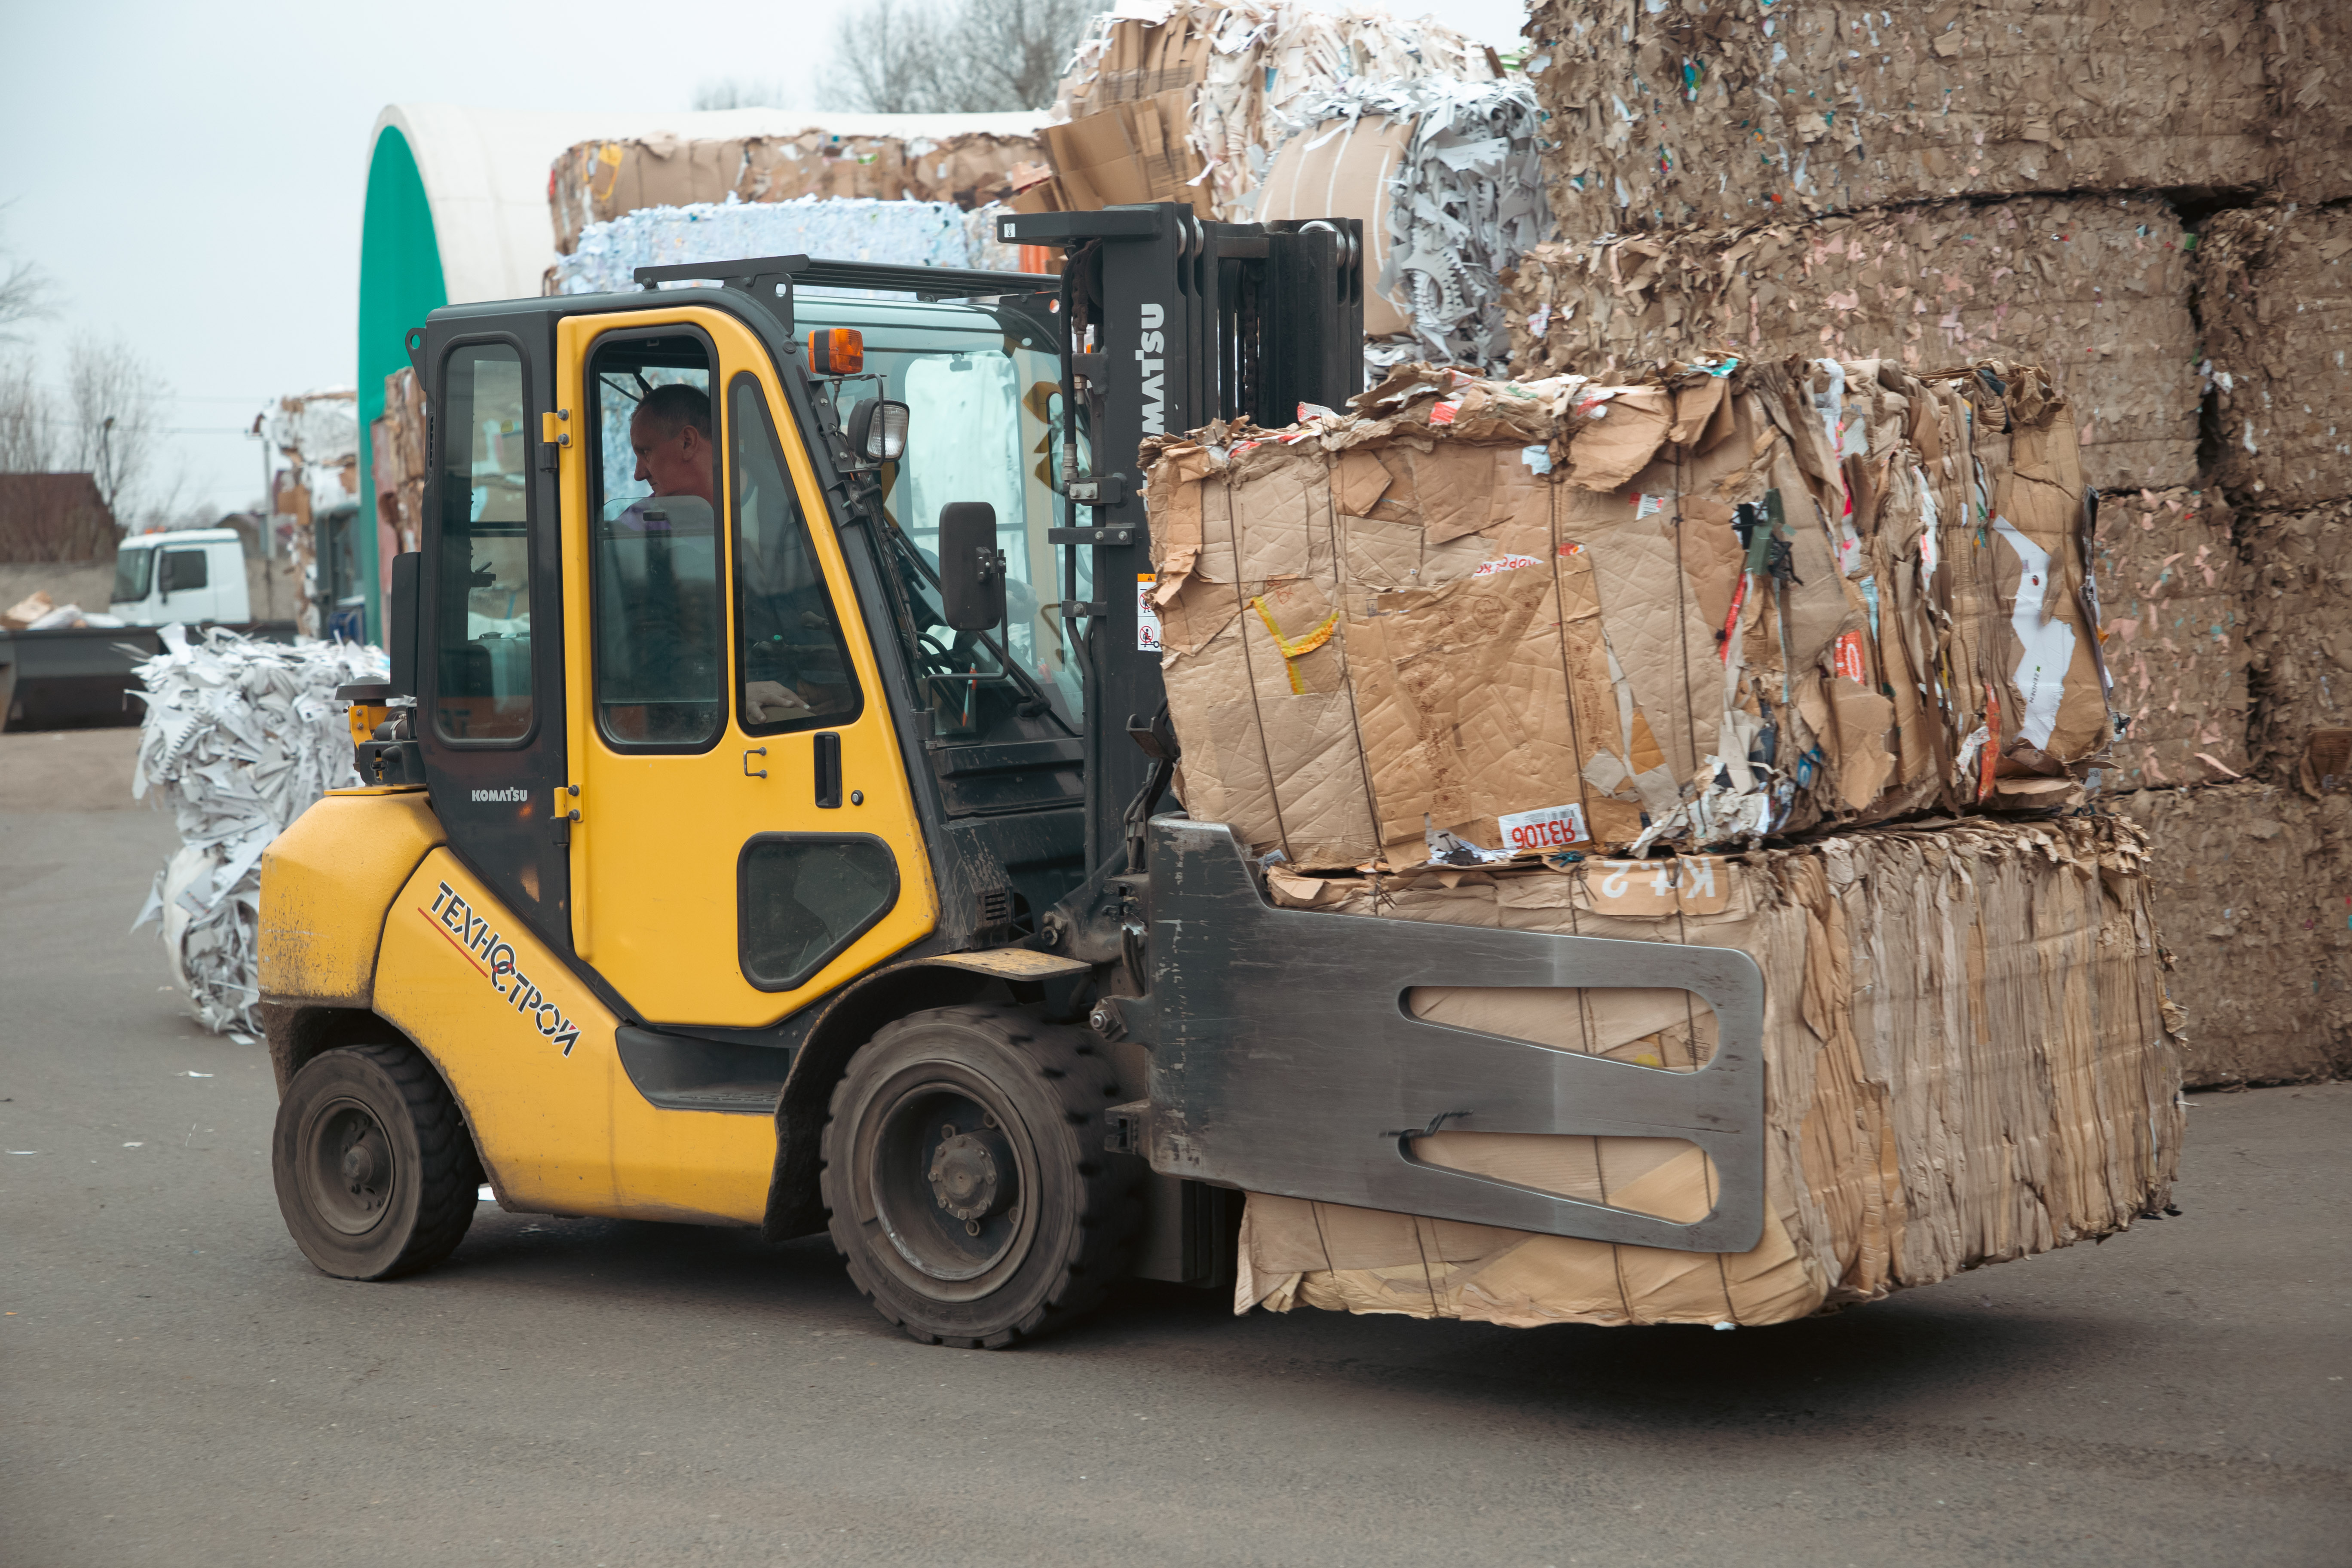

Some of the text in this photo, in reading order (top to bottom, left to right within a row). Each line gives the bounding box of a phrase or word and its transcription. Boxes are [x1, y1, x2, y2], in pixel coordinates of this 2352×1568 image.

[1135, 304, 1164, 489] MATSU
[2029, 673, 2039, 703] ZENDEN
[472, 787, 527, 802] KOMATSU
[430, 880, 582, 1058] ТЕХНОСТРОЙ
